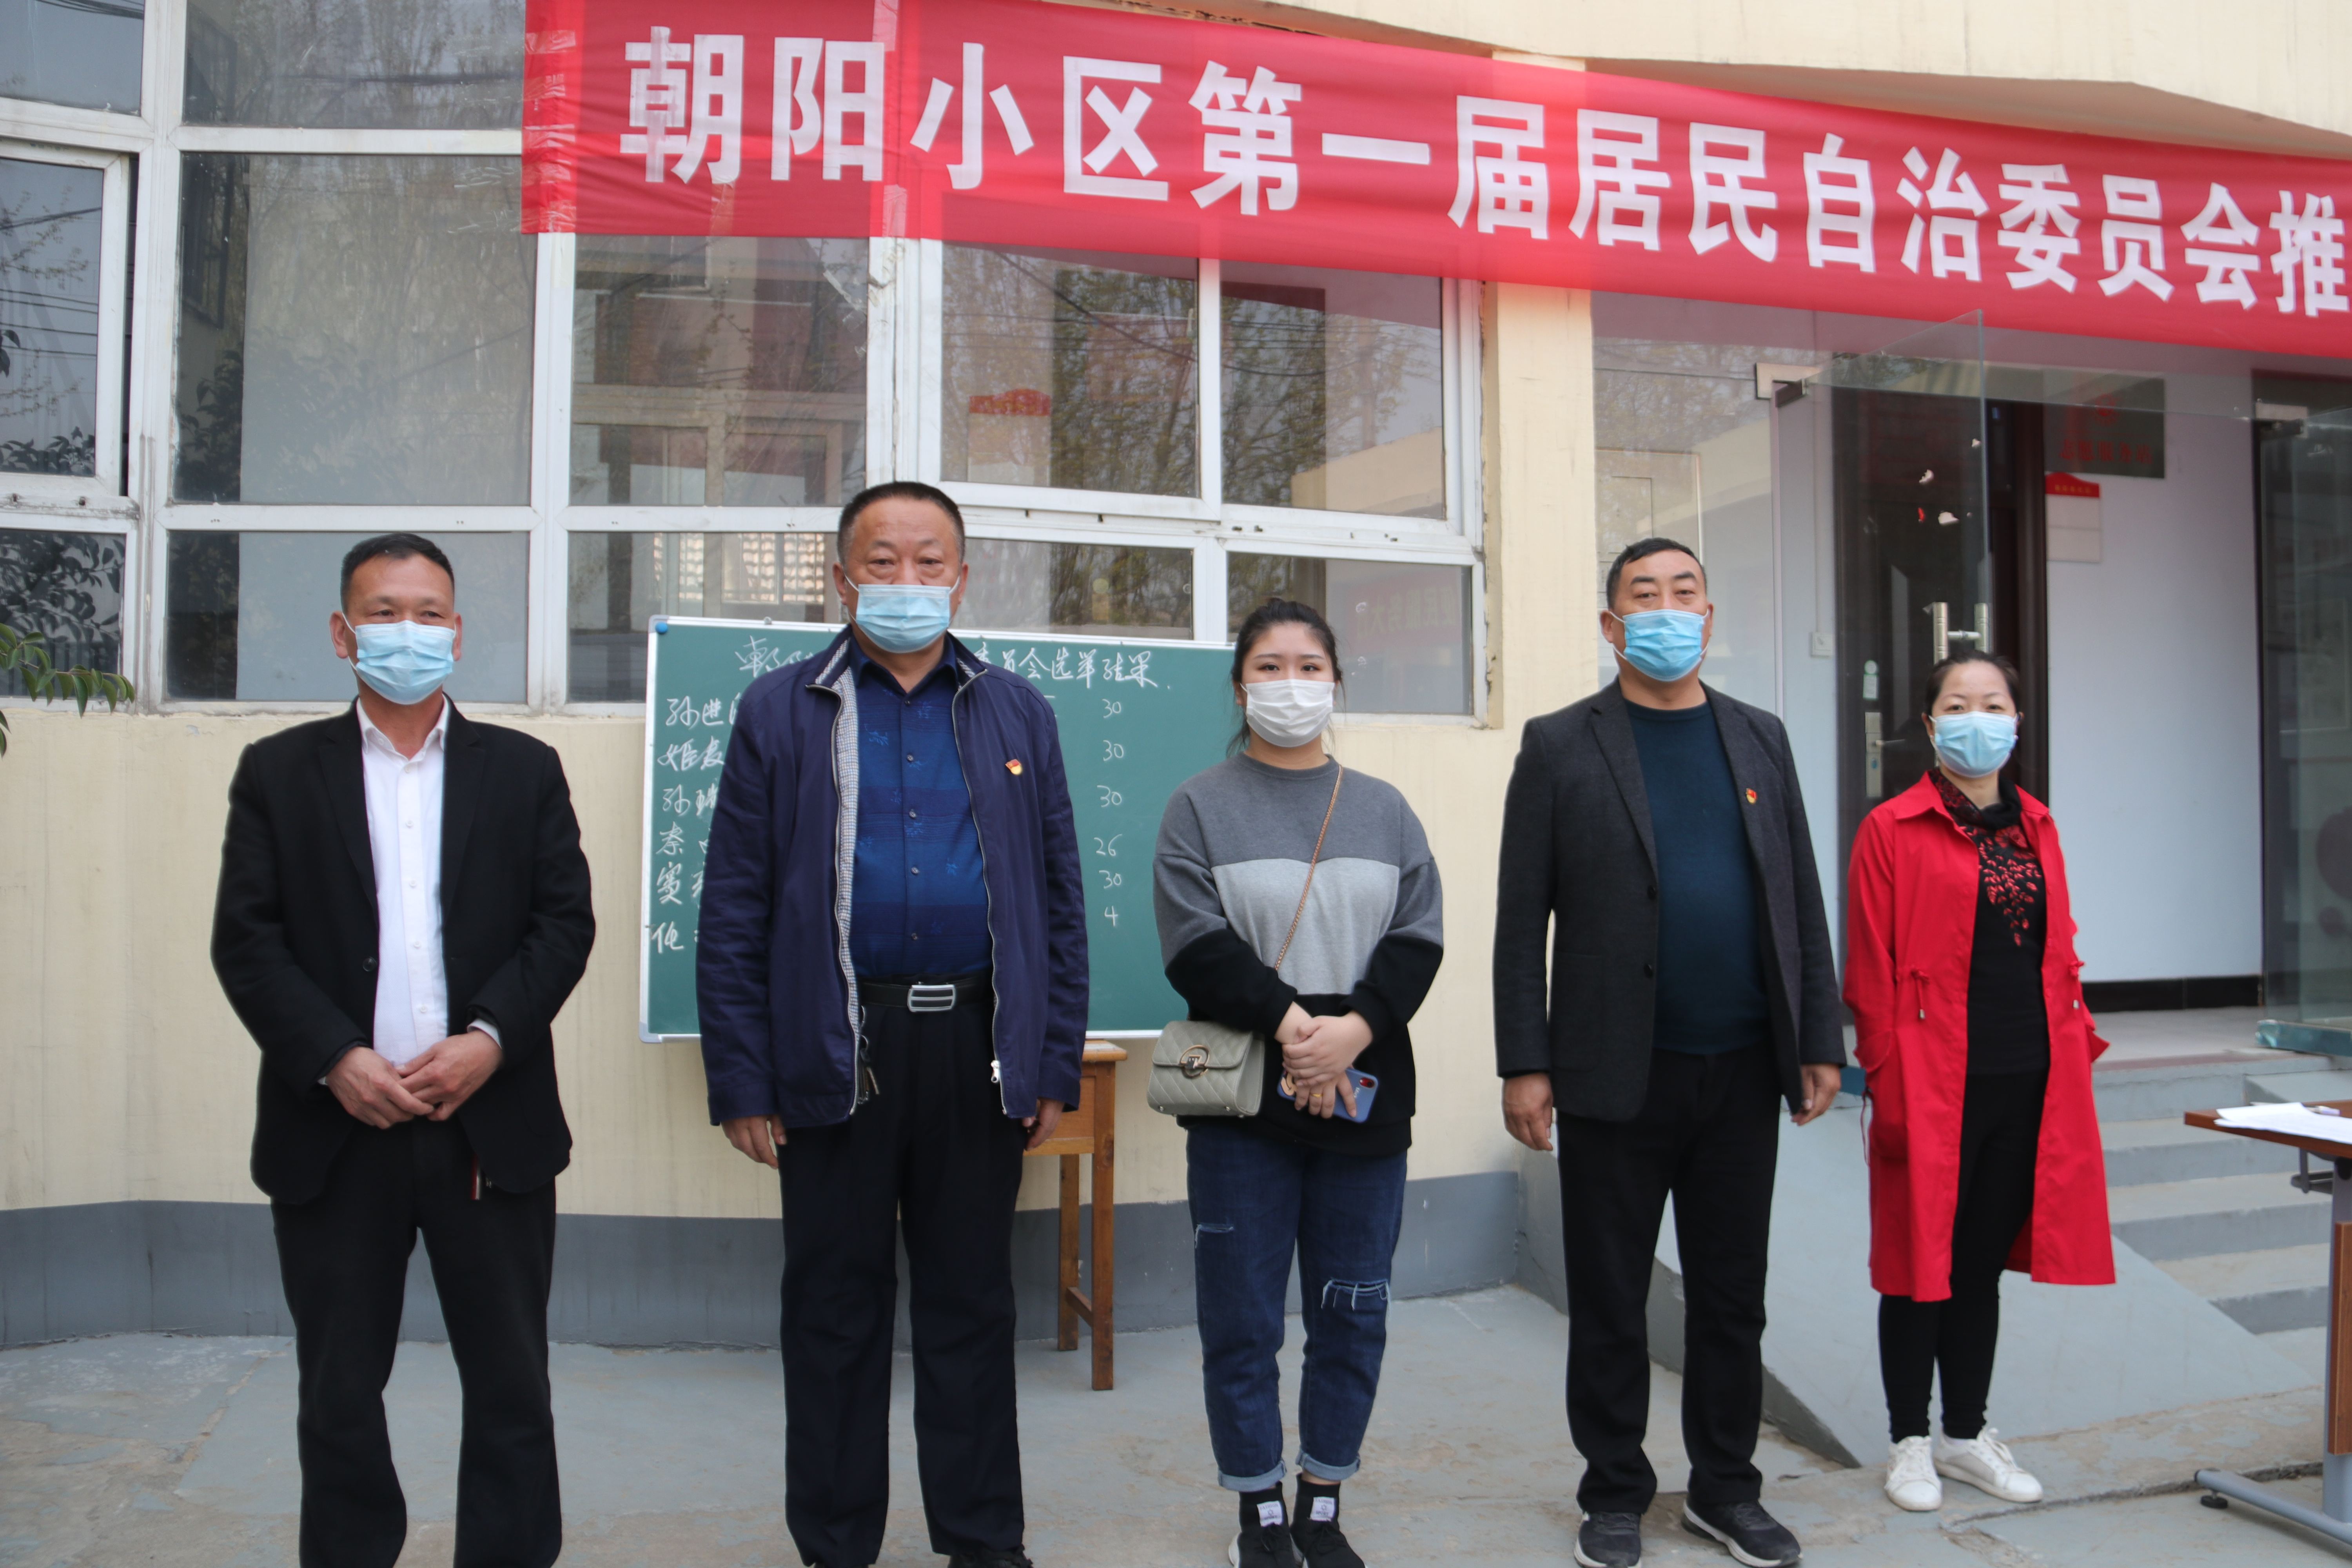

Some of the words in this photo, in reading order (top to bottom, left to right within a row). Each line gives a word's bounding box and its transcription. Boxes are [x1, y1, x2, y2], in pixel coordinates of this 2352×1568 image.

[620, 25, 2351, 318] 朝阳小区第一届居民自治委员会推
[1102, 699, 1122, 719] 30
[1103, 740, 1124, 761] 30
[1097, 785, 1122, 808] 30
[1094, 833, 1123, 856] 26
[1099, 870, 1122, 889] 30
[1104, 906, 1119, 926] 4
